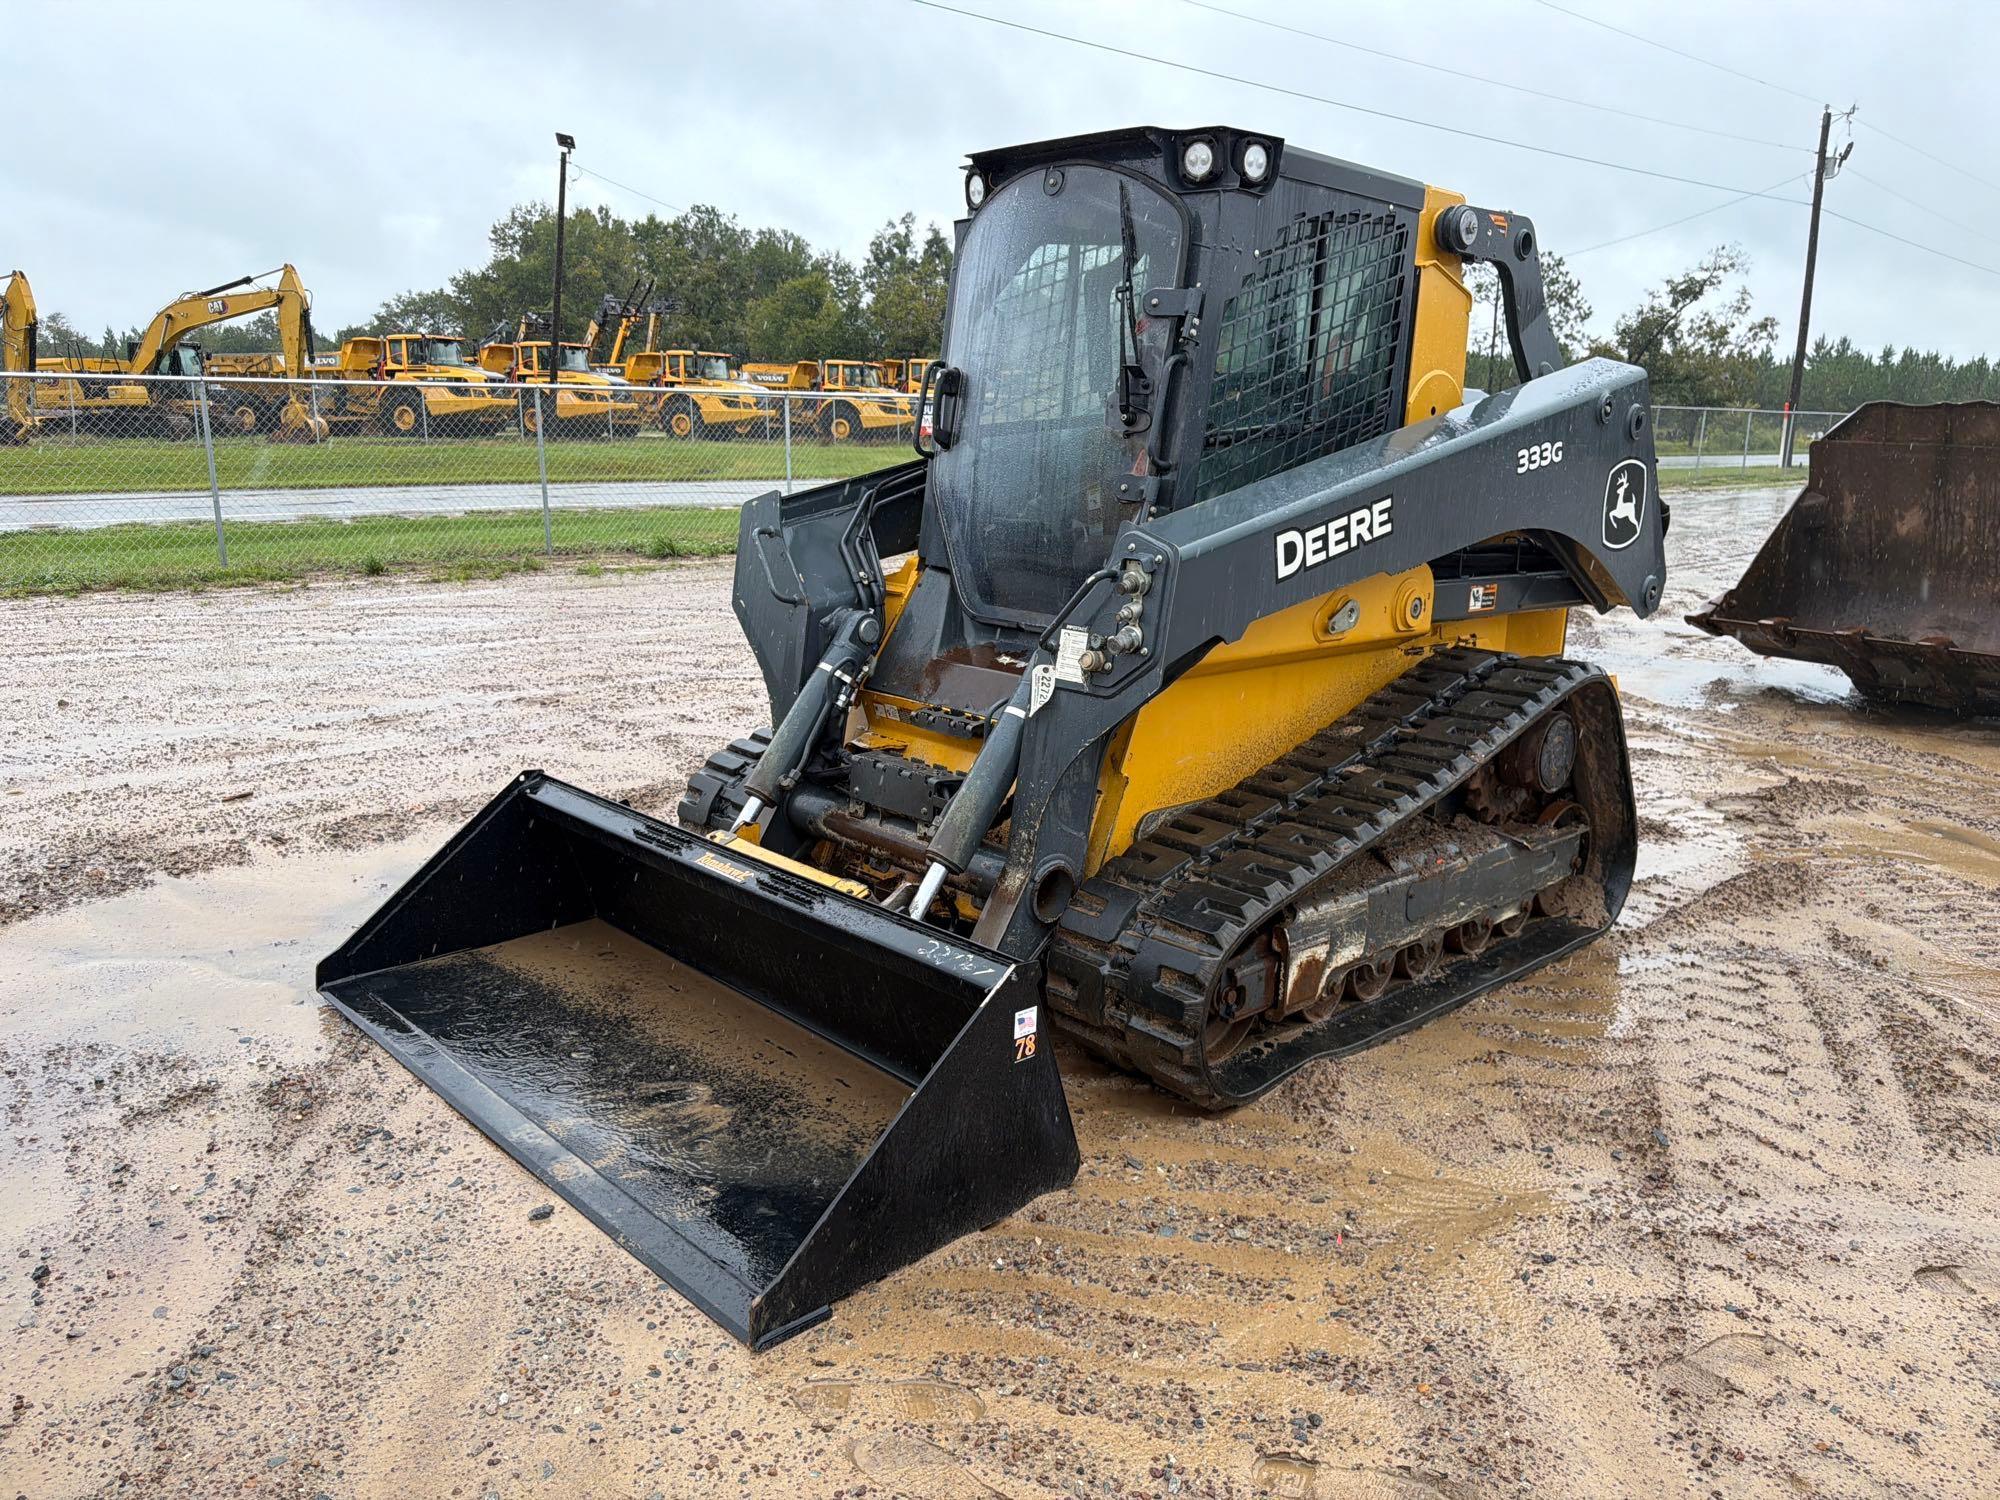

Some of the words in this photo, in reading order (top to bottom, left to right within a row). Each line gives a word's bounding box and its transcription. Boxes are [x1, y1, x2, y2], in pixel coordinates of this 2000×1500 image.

[208, 300, 223, 313] CAT
[756, 374, 785, 382] VOLVO
[1516, 441, 1563, 474] 333G
[1276, 498, 1393, 579] DEERE
[1015, 1034, 1036, 1060] 78
